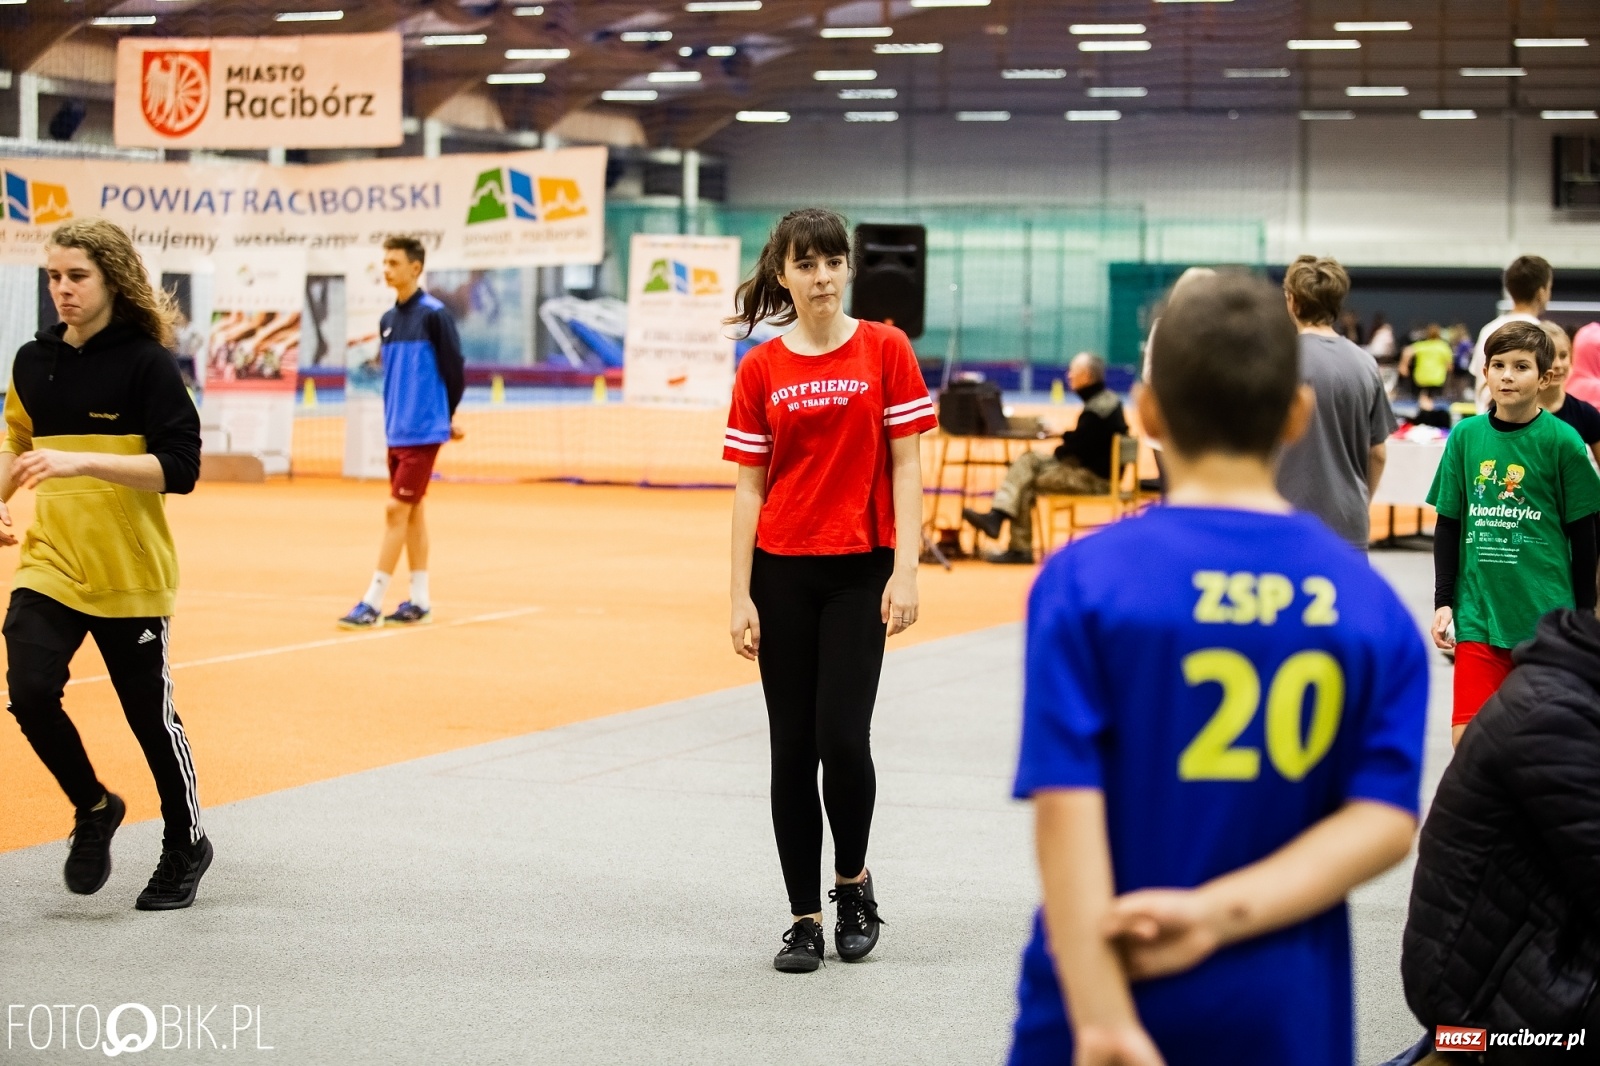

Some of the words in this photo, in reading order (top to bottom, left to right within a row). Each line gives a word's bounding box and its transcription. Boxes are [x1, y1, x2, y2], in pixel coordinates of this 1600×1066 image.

[226, 64, 304, 83] MIASTO
[225, 83, 375, 119] Racibórz
[100, 183, 233, 215] POWIAT
[241, 181, 442, 215] RACIBORSKI
[131, 225, 219, 256] icujemy
[771, 379, 869, 406] BOYFRIEND?
[787, 401, 800, 412] NO
[802, 396, 831, 408] THANK
[833, 396, 849, 406] YOU
[1192, 569, 1295, 627] ZSP
[1301, 574, 1339, 627] 2
[1177, 645, 1346, 783] 20
